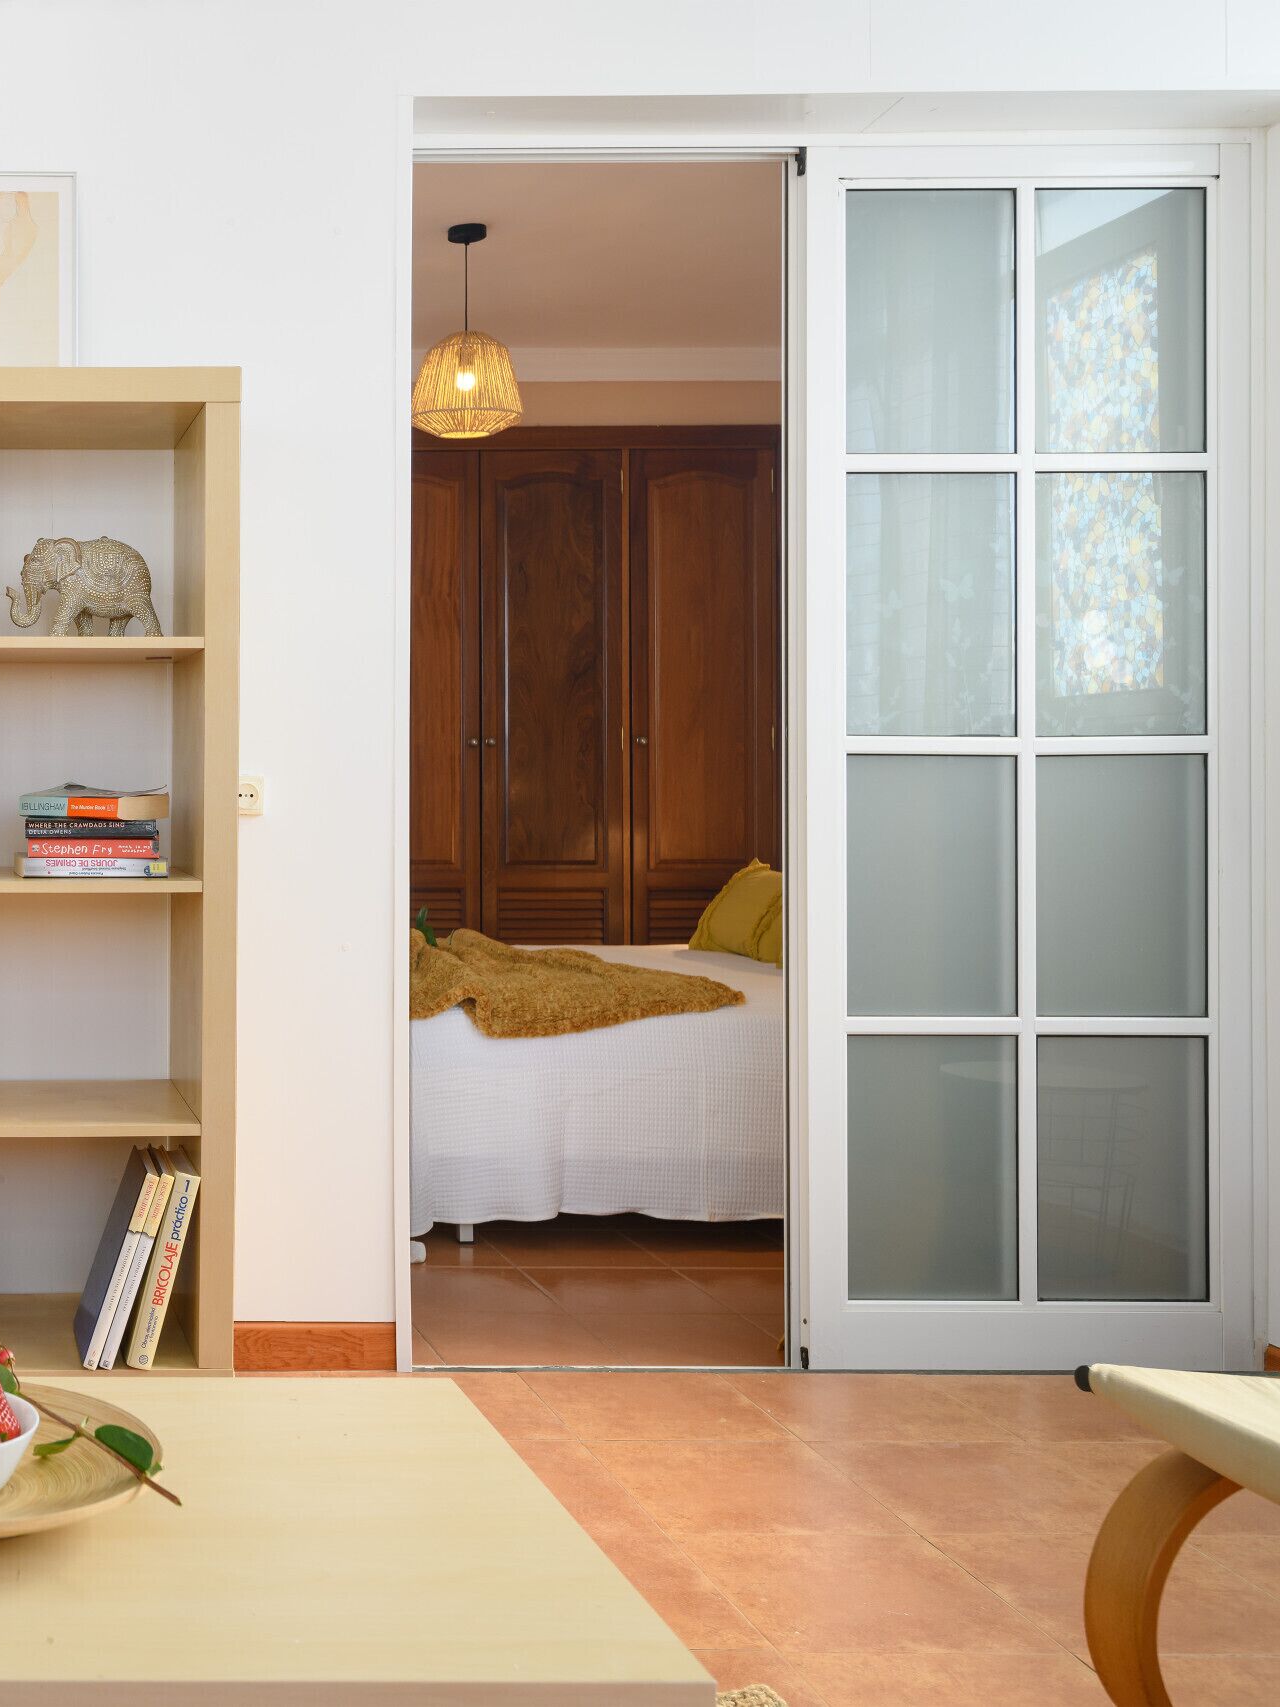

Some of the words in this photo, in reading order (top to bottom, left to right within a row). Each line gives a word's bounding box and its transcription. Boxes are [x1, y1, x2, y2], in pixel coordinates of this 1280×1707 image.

[42, 842, 88, 855] Stephen
[92, 844, 112, 856] Fry
[152, 1242, 178, 1306] BRICOLAJE
[171, 1196, 188, 1241] práctico
[185, 1180, 190, 1192] 1
